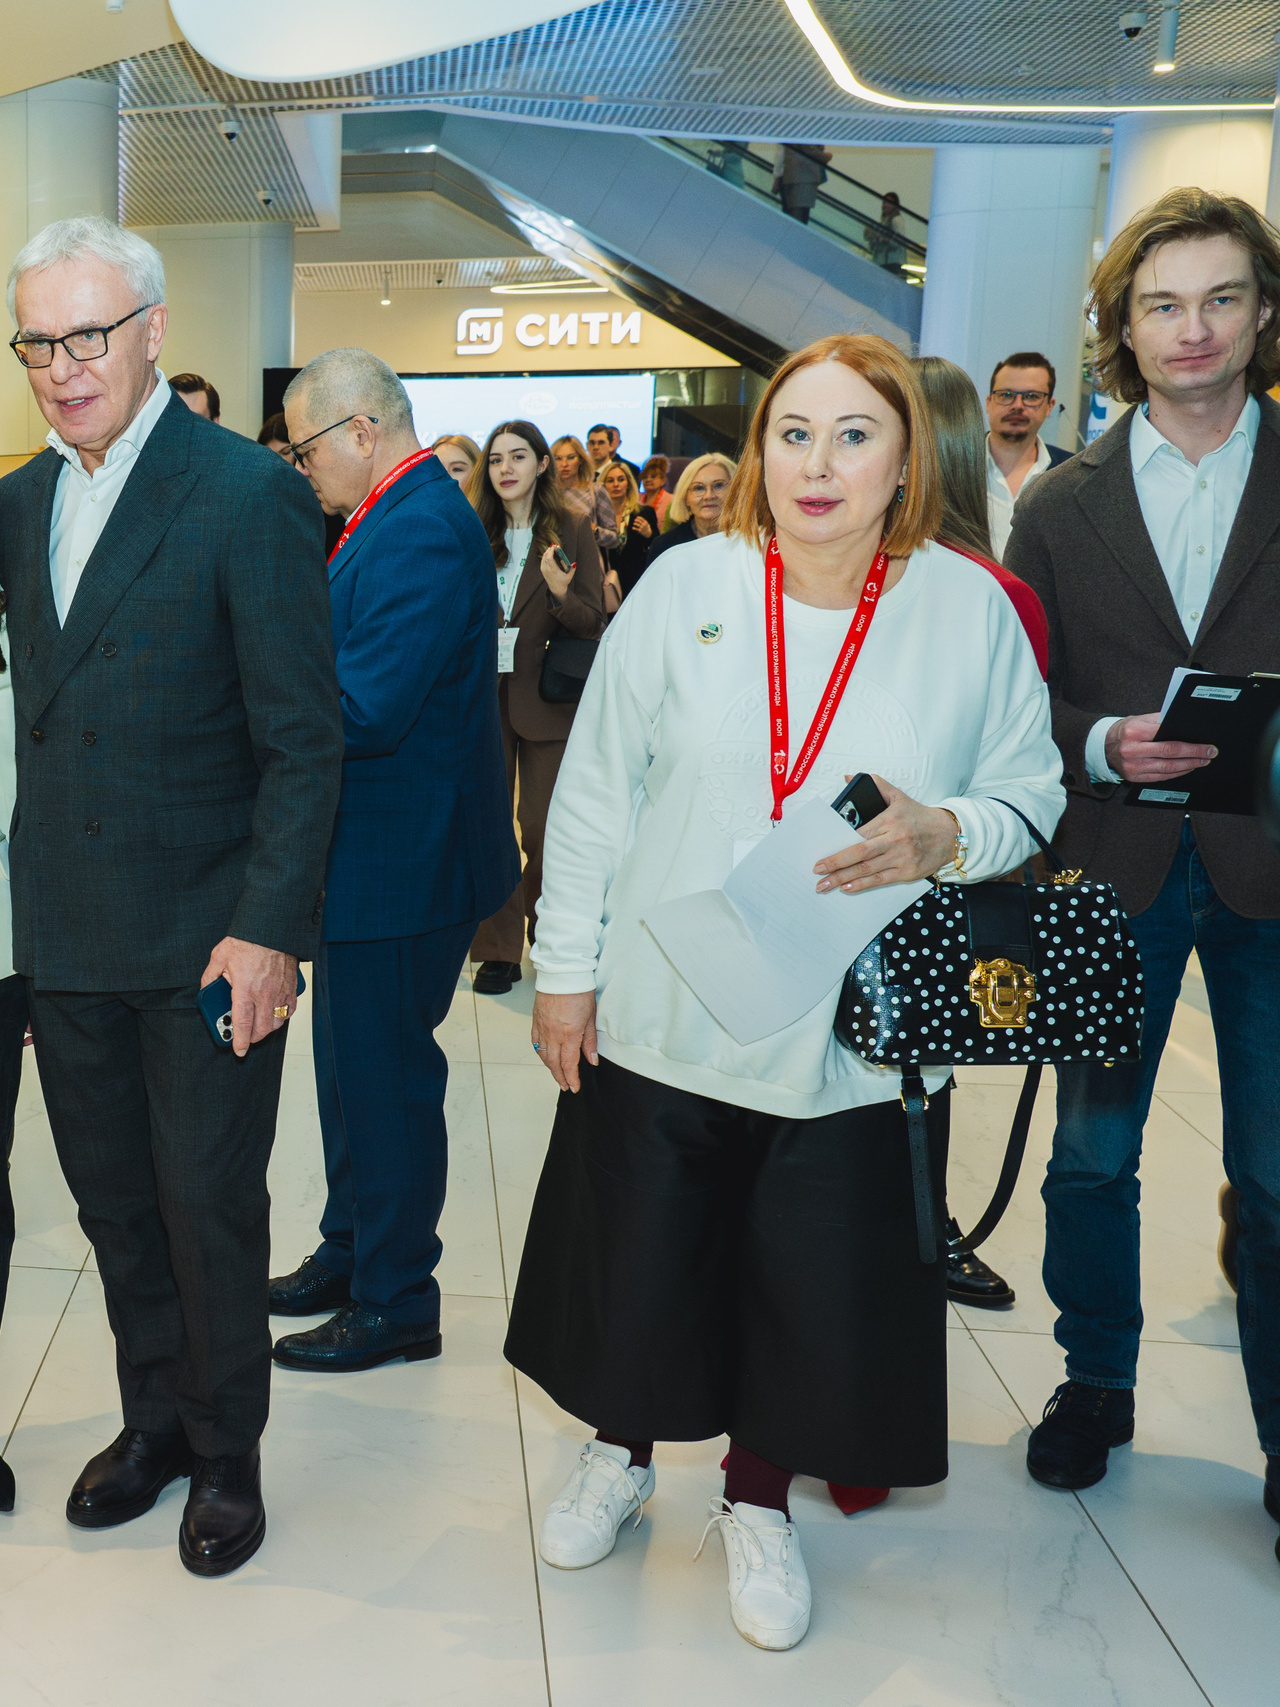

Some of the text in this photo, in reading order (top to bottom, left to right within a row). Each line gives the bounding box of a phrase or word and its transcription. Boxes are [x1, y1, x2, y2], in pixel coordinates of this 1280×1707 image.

[515, 311, 642, 347] СИТИ
[770, 567, 779, 616] ВСЕРОССИЙСКОЕ
[771, 616, 779, 650] ОБЩЕСТВО
[772, 649, 780, 676] ОХРАНЫ
[774, 676, 782, 707] ПРИРОДЫ
[793, 731, 821, 783] ВСЕРОССИЙСКОЕ
[816, 699, 834, 732] ОБЩЕСТВО
[829, 673, 844, 699] ОХРАНЫ
[839, 643, 856, 674] ПРИРОДЫ
[855, 614, 867, 632] ВООП
[775, 718, 783, 737] ВООП
